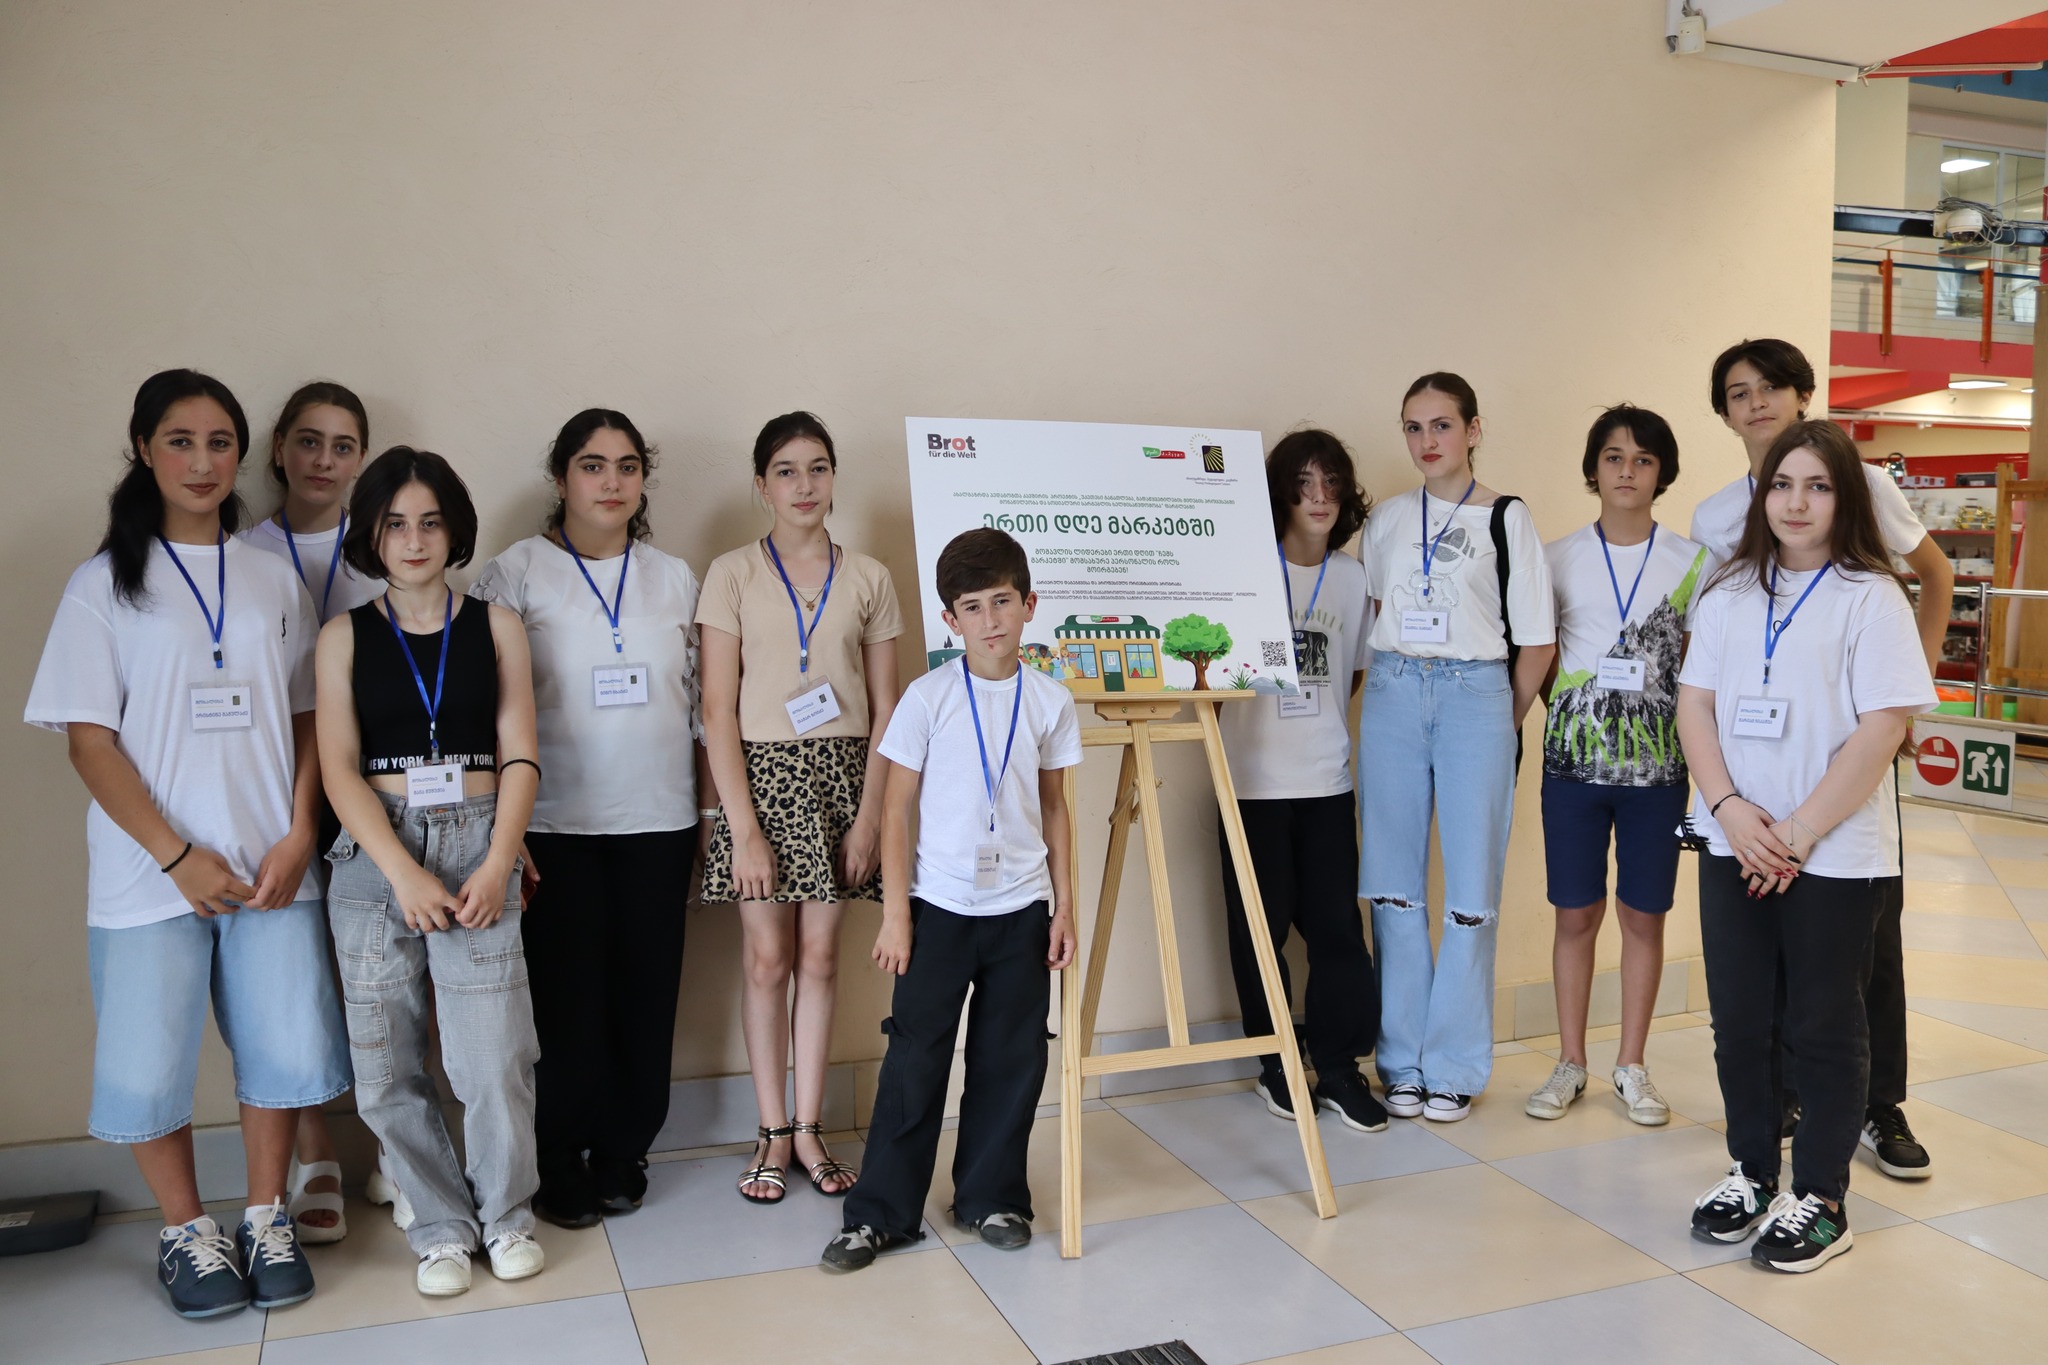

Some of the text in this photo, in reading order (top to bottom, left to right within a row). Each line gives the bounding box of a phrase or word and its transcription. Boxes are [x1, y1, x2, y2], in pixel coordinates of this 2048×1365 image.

[927, 433, 976, 451] Brot
[929, 450, 941, 458] für
[957, 451, 976, 459] Welt
[983, 513, 1215, 537] ერთი დღე მარკეტში
[391, 755, 425, 769] YORK
[444, 754, 494, 766] NEW YORK
